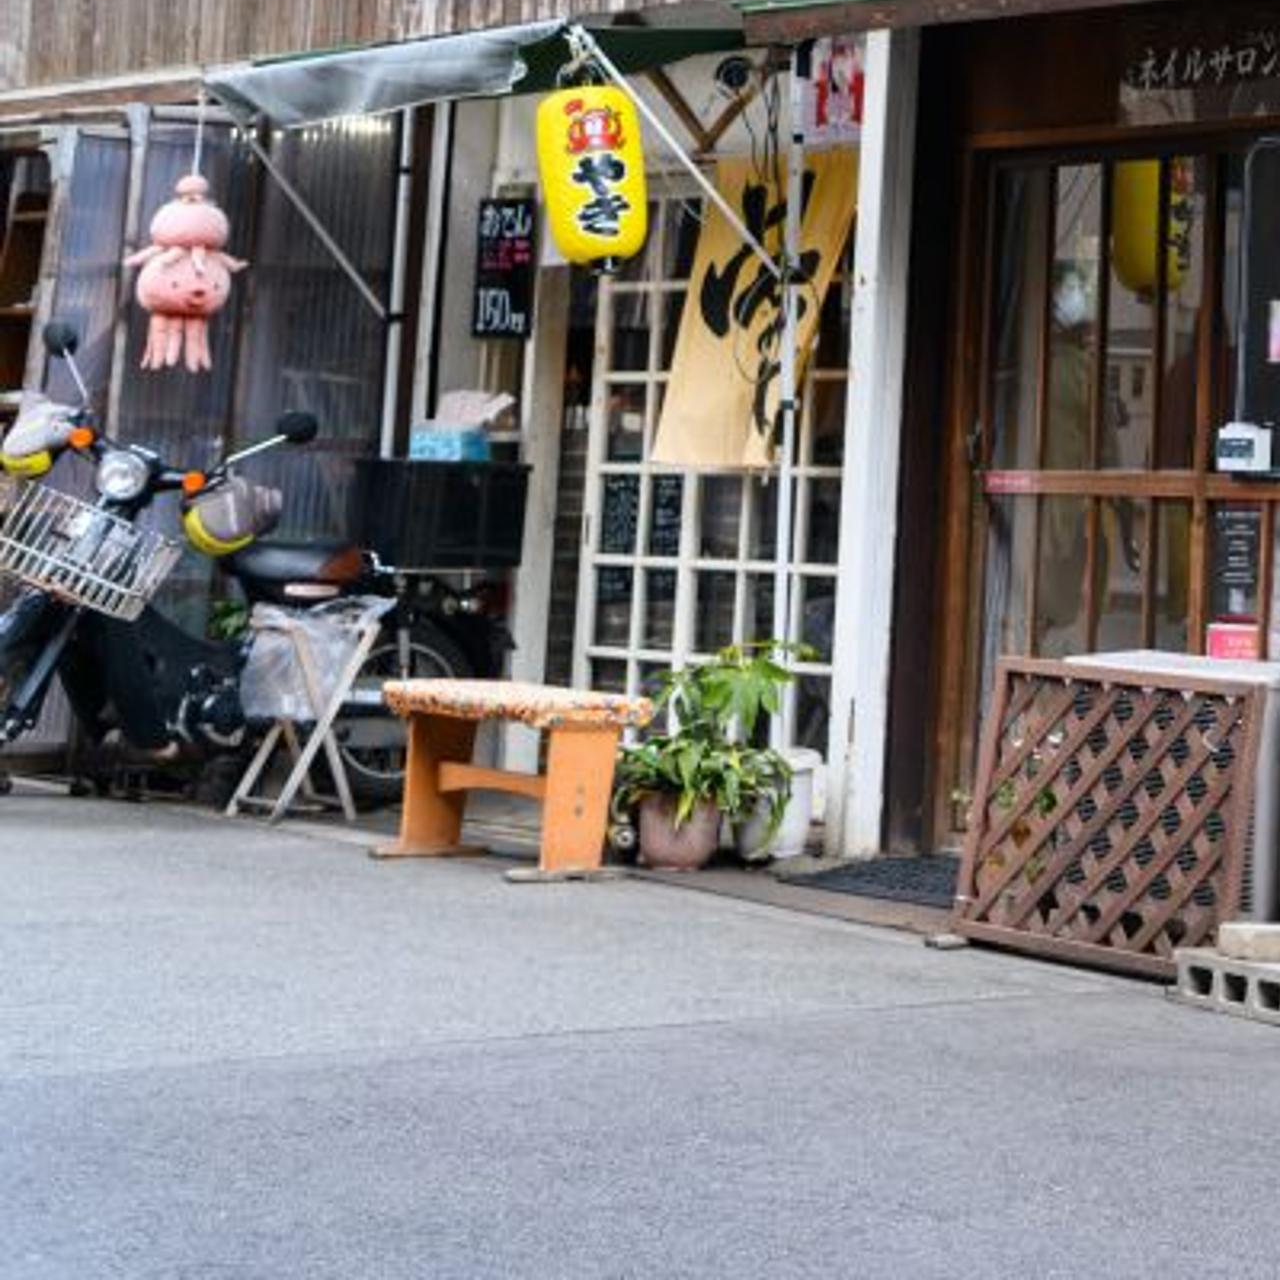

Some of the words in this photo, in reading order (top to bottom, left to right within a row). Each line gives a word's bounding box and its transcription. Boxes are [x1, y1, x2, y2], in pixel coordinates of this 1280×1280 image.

[1139, 42, 1280, 91] ネイルサロン
